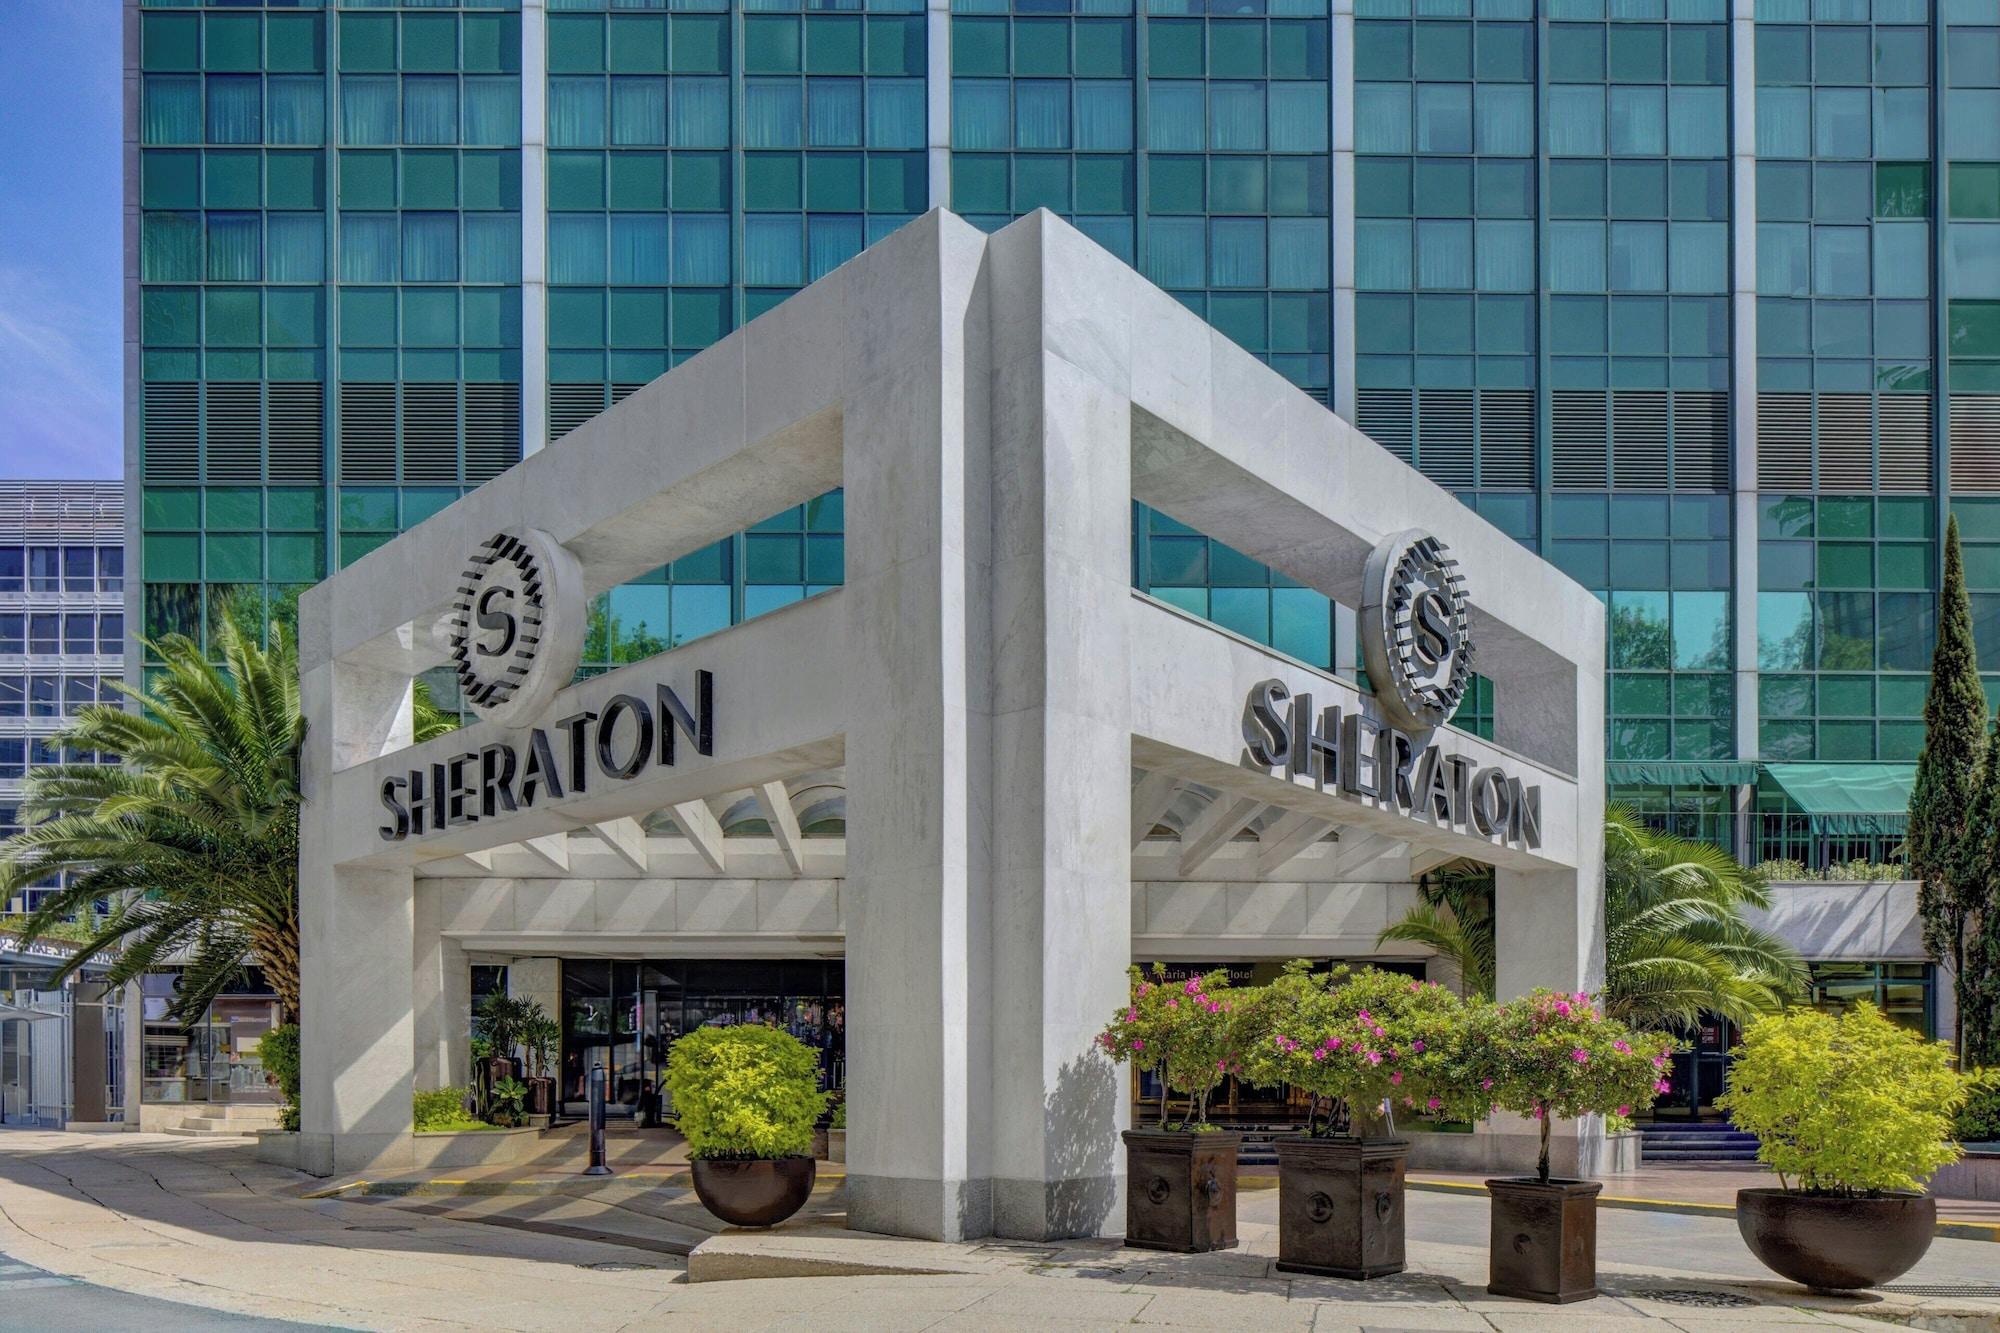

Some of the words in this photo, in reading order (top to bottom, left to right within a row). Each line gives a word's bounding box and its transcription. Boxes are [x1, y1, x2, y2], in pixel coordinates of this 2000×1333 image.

[476, 585, 516, 656] S
[1413, 589, 1452, 663] S
[378, 669, 713, 841] SHERATON
[1243, 678, 1541, 848] SHERATON
